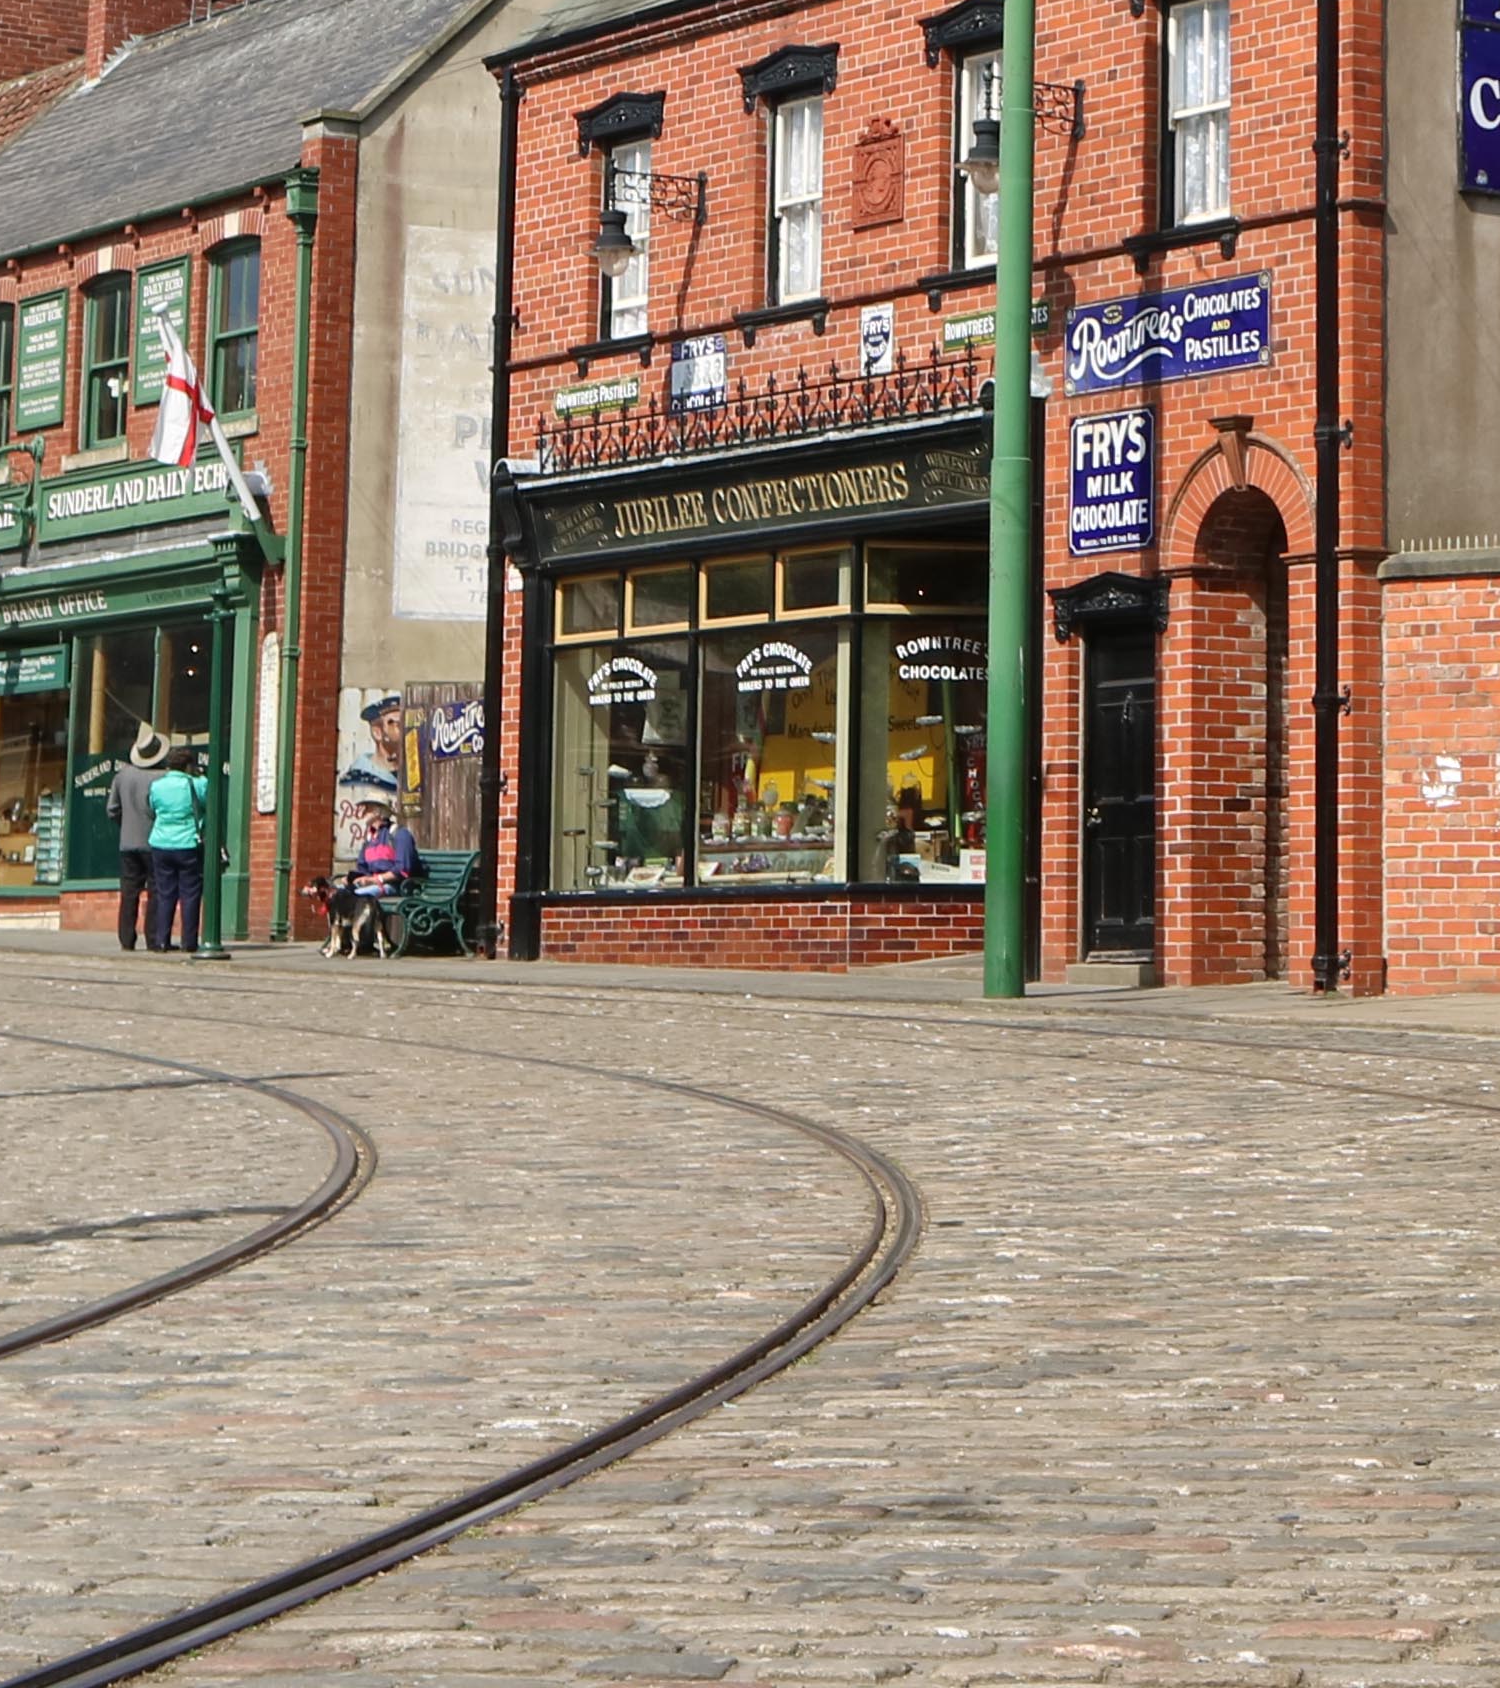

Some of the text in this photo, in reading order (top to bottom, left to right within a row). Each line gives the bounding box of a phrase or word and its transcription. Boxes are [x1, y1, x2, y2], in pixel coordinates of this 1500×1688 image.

[143, 277, 183, 298] DAILY ECHO
[1184, 287, 1261, 322] CHOCOLATES
[1211, 319, 1231, 332] AND
[1185, 330, 1261, 363] PASTILLES
[1076, 415, 1146, 471] FRY'S
[48, 477, 144, 518] SUNDERLAND
[146, 469, 190, 502] DAILY
[614, 462, 909, 539] JUBILEE CONFECTIONERS
[1087, 471, 1135, 498] MILK
[1072, 499, 1148, 533] CHOCOLATE
[426, 541, 488, 559] BRIDG
[3, 599, 52, 623] BRANCH
[59, 590, 107, 615] OFFICE
[588, 657, 658, 692] FRY'S CHOCOLATE
[736, 641, 813, 679] FRY'S CHOCOLATE
